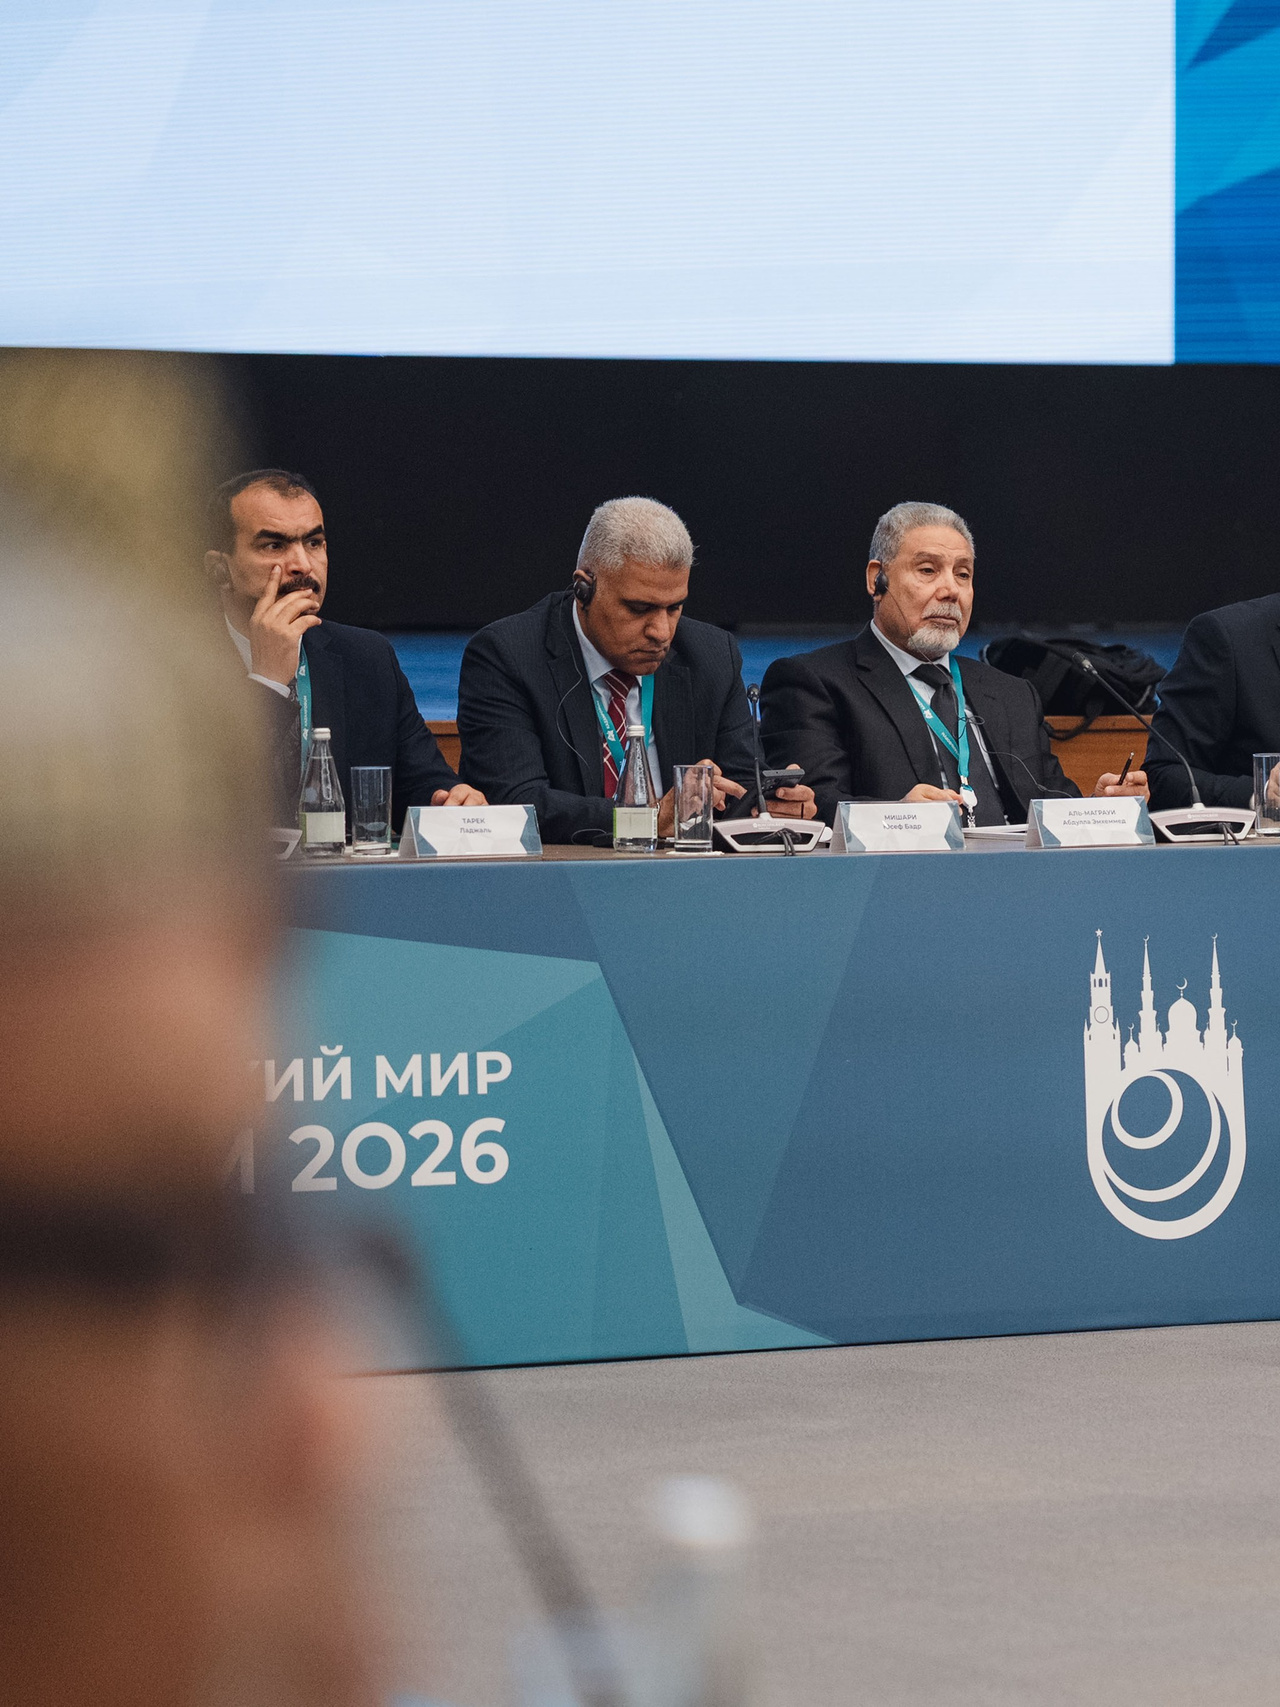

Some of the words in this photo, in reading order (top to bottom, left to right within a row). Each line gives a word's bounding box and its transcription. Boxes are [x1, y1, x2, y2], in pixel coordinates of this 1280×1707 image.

[904, 823, 922, 831] Бадр
[249, 1044, 353, 1102] ИЙ
[376, 1051, 513, 1099] МИР
[288, 1117, 511, 1193] 2026
